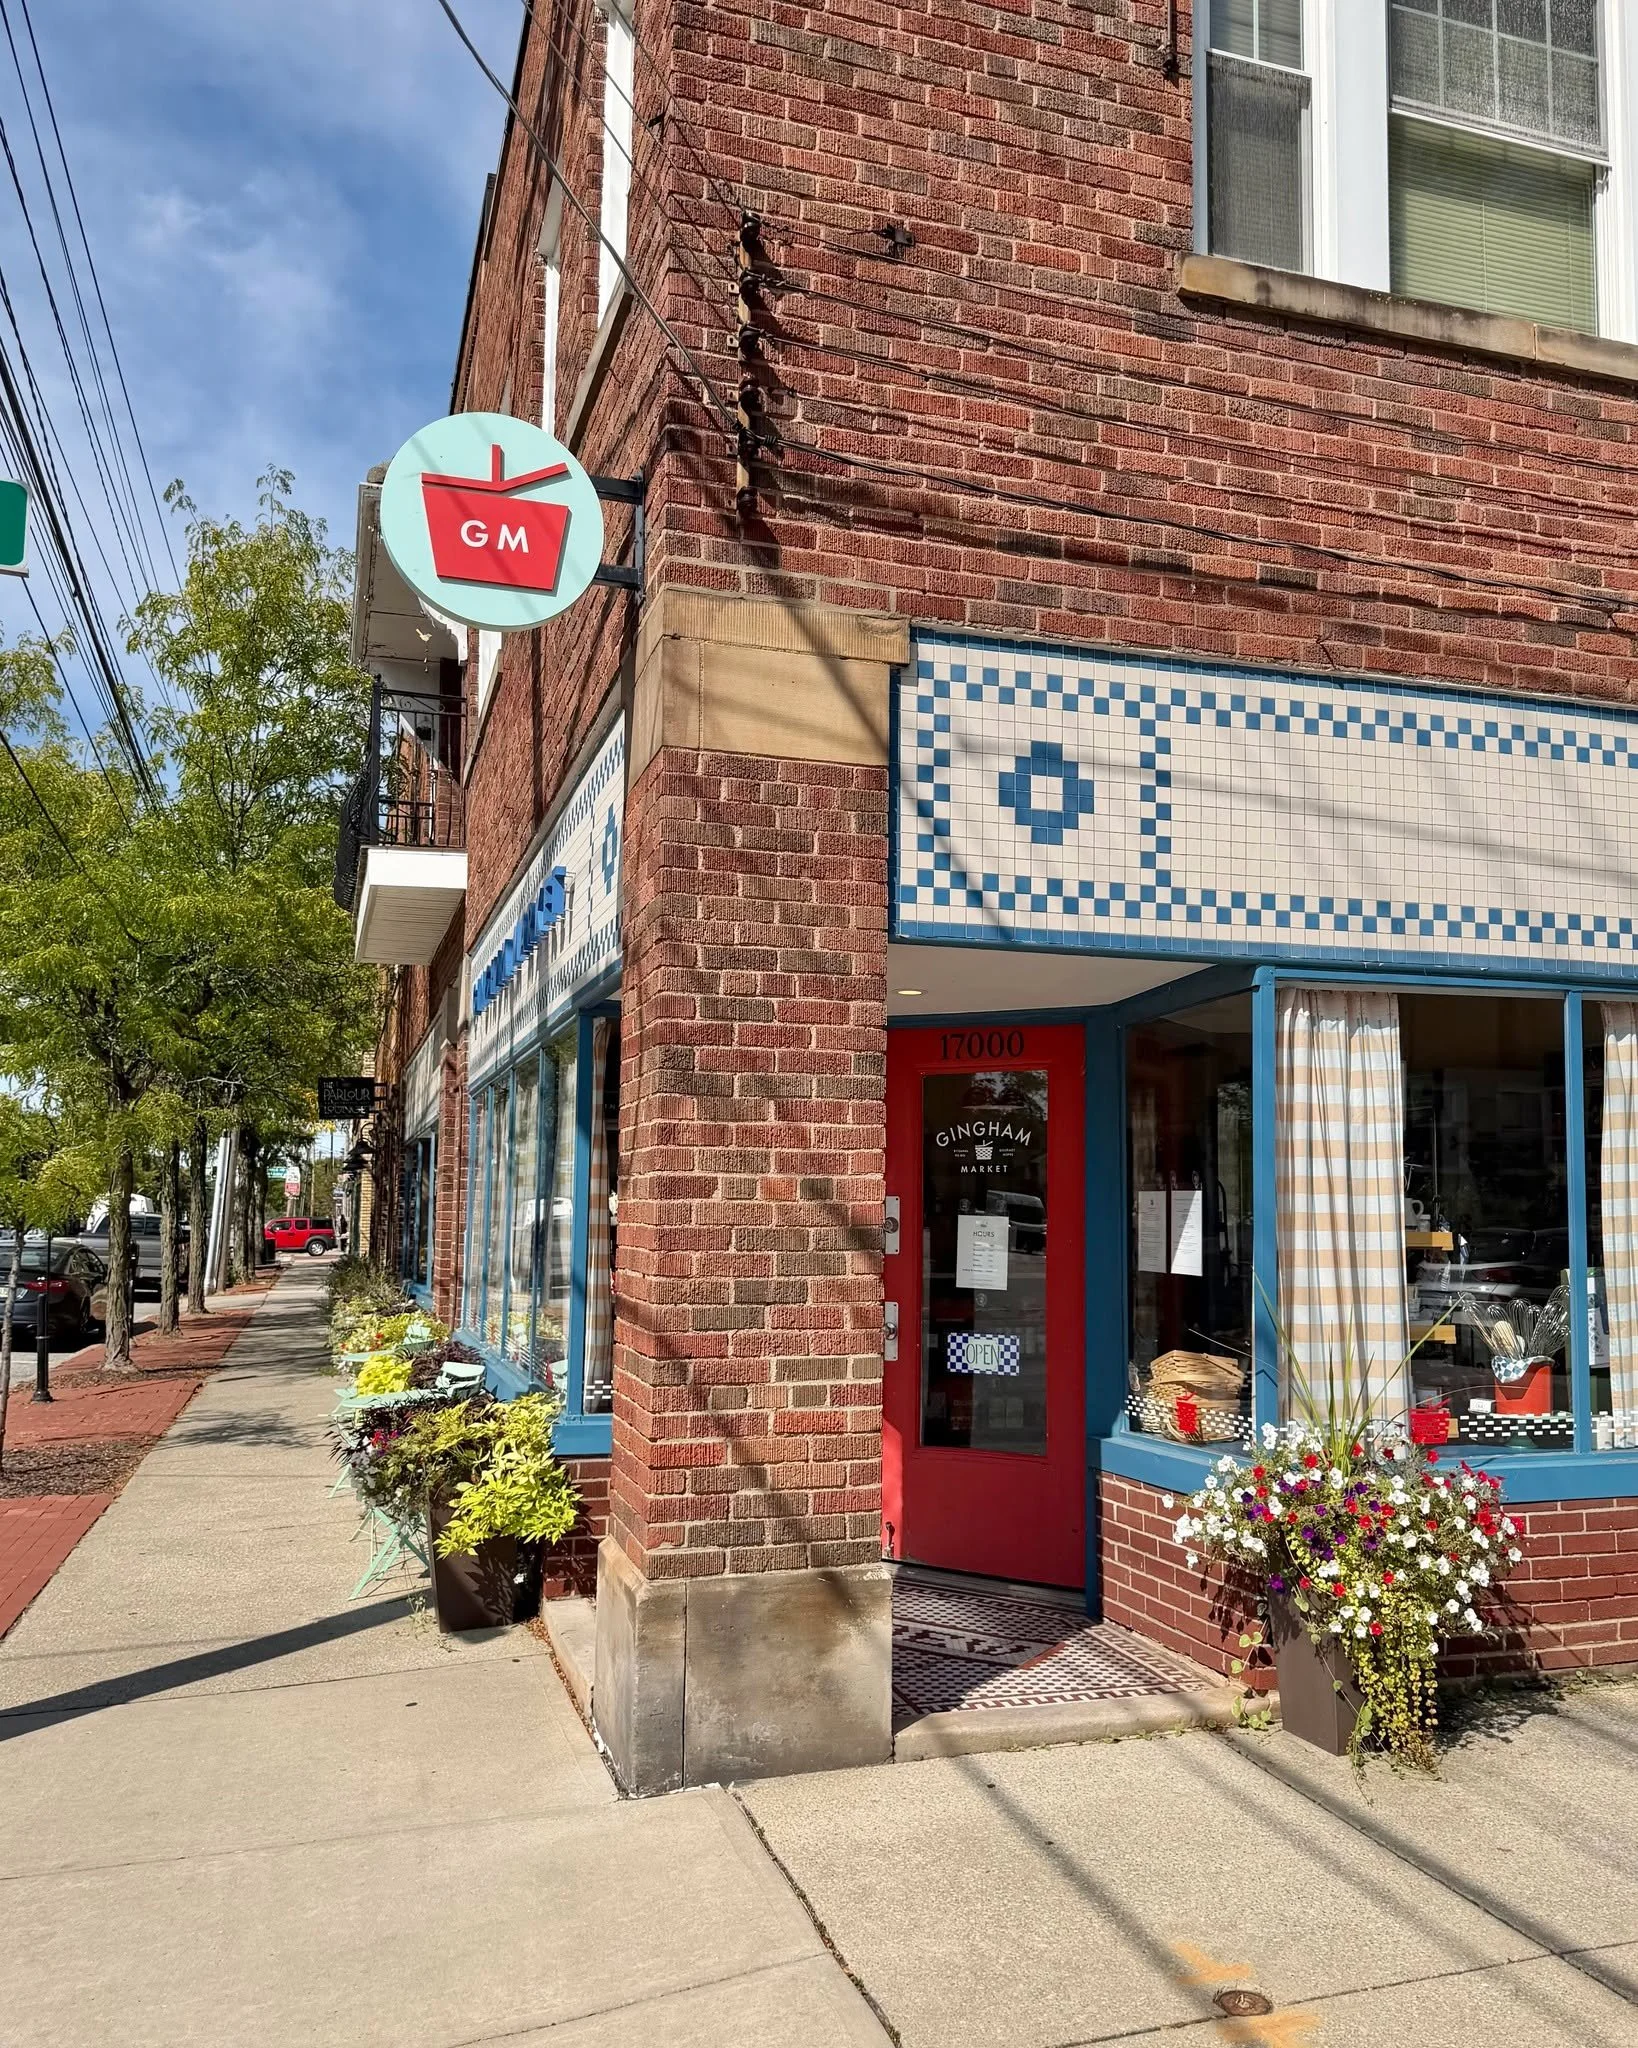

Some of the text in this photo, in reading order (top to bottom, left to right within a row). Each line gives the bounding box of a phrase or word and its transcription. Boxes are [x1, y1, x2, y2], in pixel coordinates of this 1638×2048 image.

[460, 519, 529, 553] GM
[941, 1030, 1024, 1060] 17000
[323, 1088, 371, 1101] PARLOUR
[936, 1121, 1031, 1147] GINGHAM
[960, 1165, 1008, 1173] MARKET
[965, 1343, 1001, 1367] OPEN
